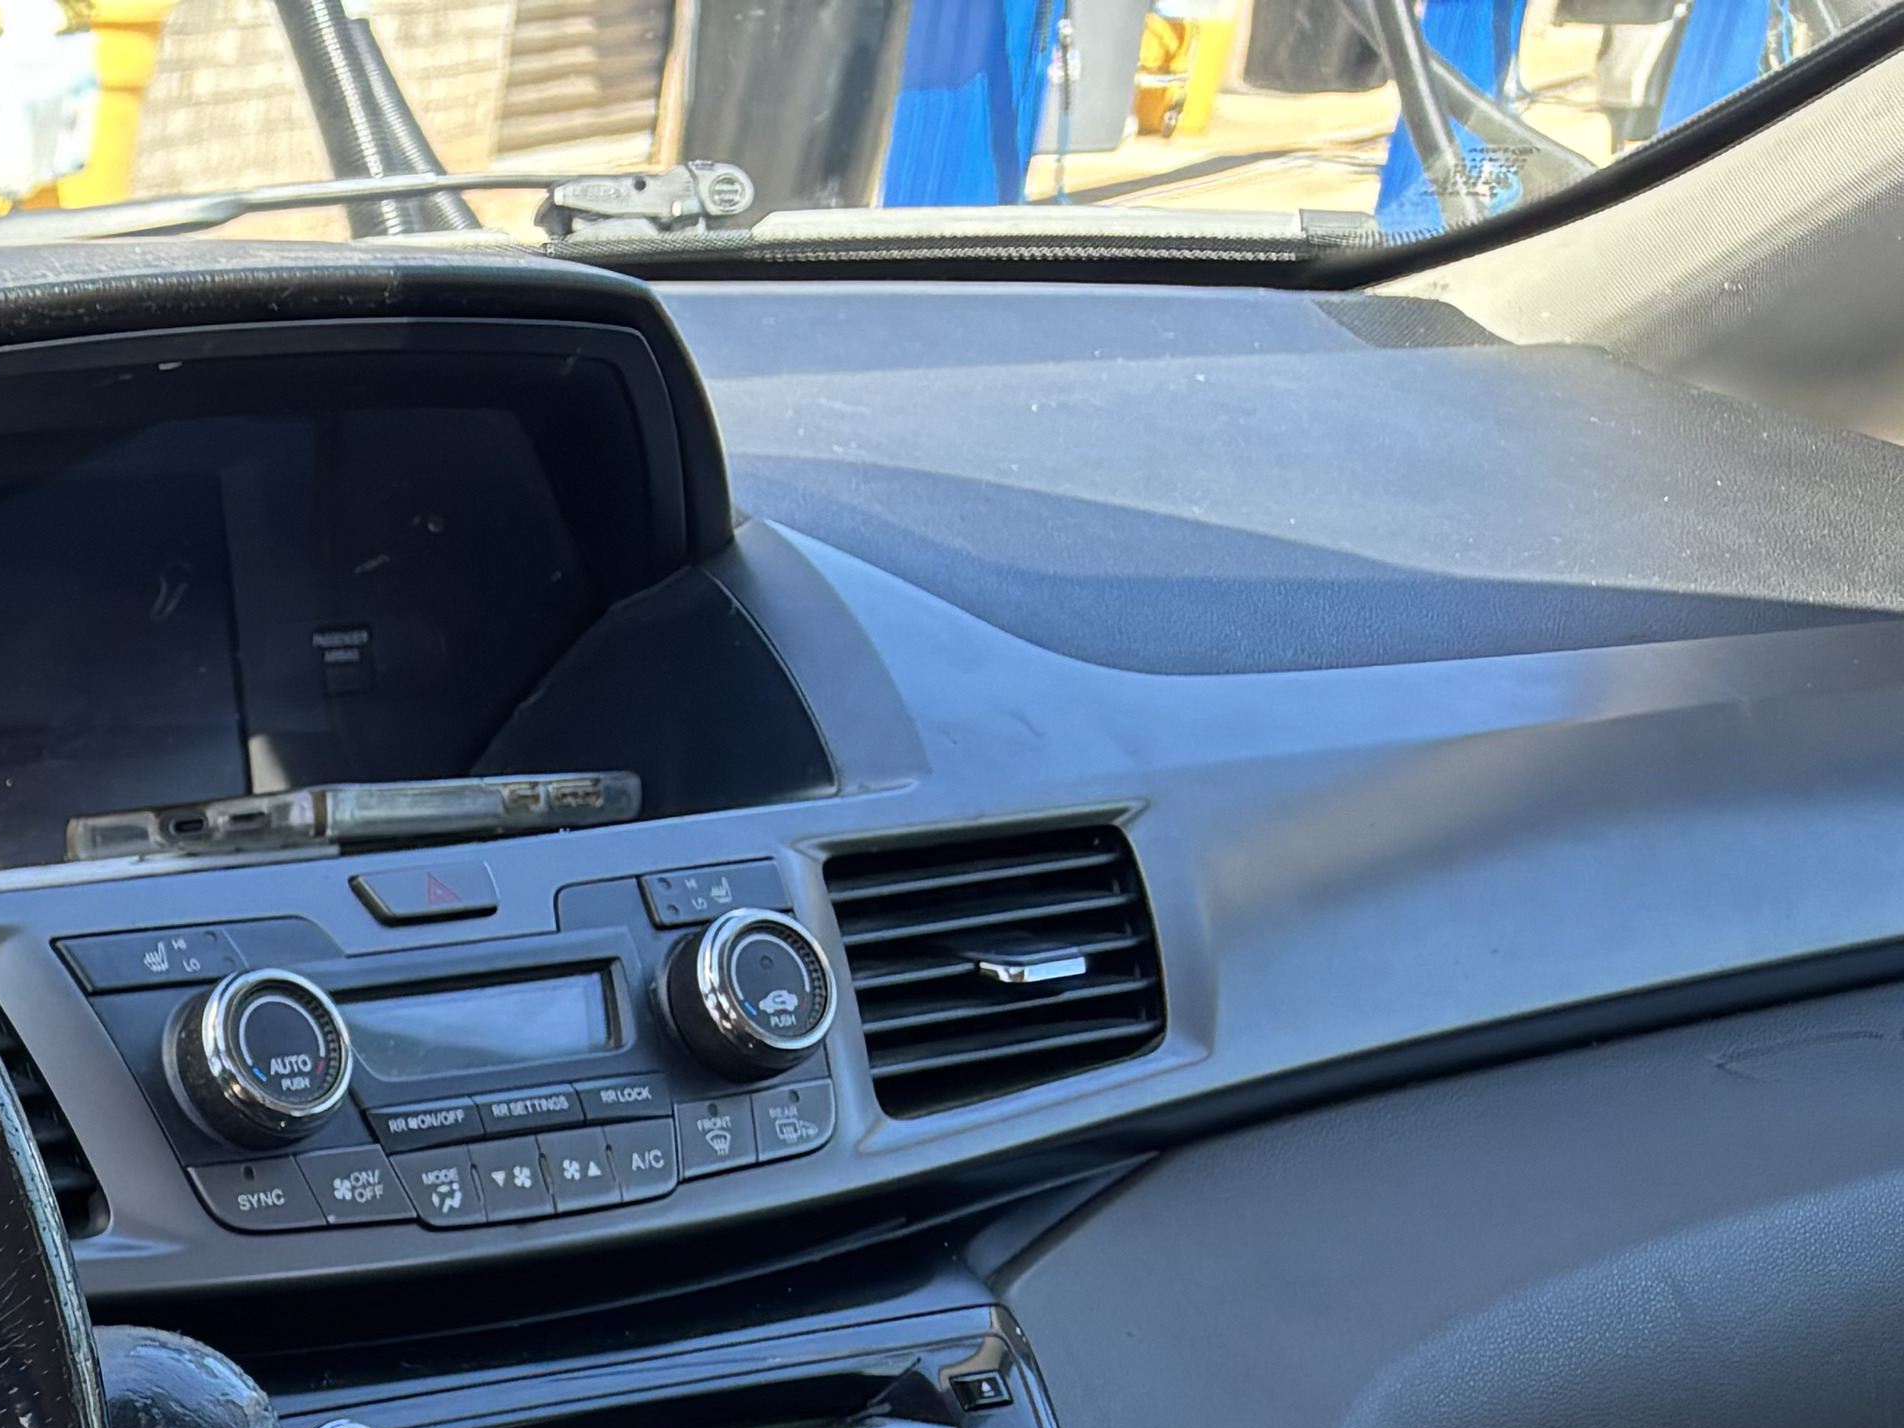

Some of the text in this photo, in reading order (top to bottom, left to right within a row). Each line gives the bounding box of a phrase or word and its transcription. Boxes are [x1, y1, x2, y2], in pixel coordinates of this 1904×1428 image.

[770, 1014, 797, 1027] PUSH
[270, 1054, 312, 1075] AUTO
[281, 1077, 310, 1091] PUSH
[615, 1086, 651, 1101] LOCK
[509, 1096, 569, 1116] SETTINGS
[697, 1116, 731, 1132] FRONT
[631, 1149, 664, 1171] A/C
[422, 1167, 459, 1185] MODE
[237, 1189, 285, 1211] SYNC
[353, 1184, 384, 1204] OFF
